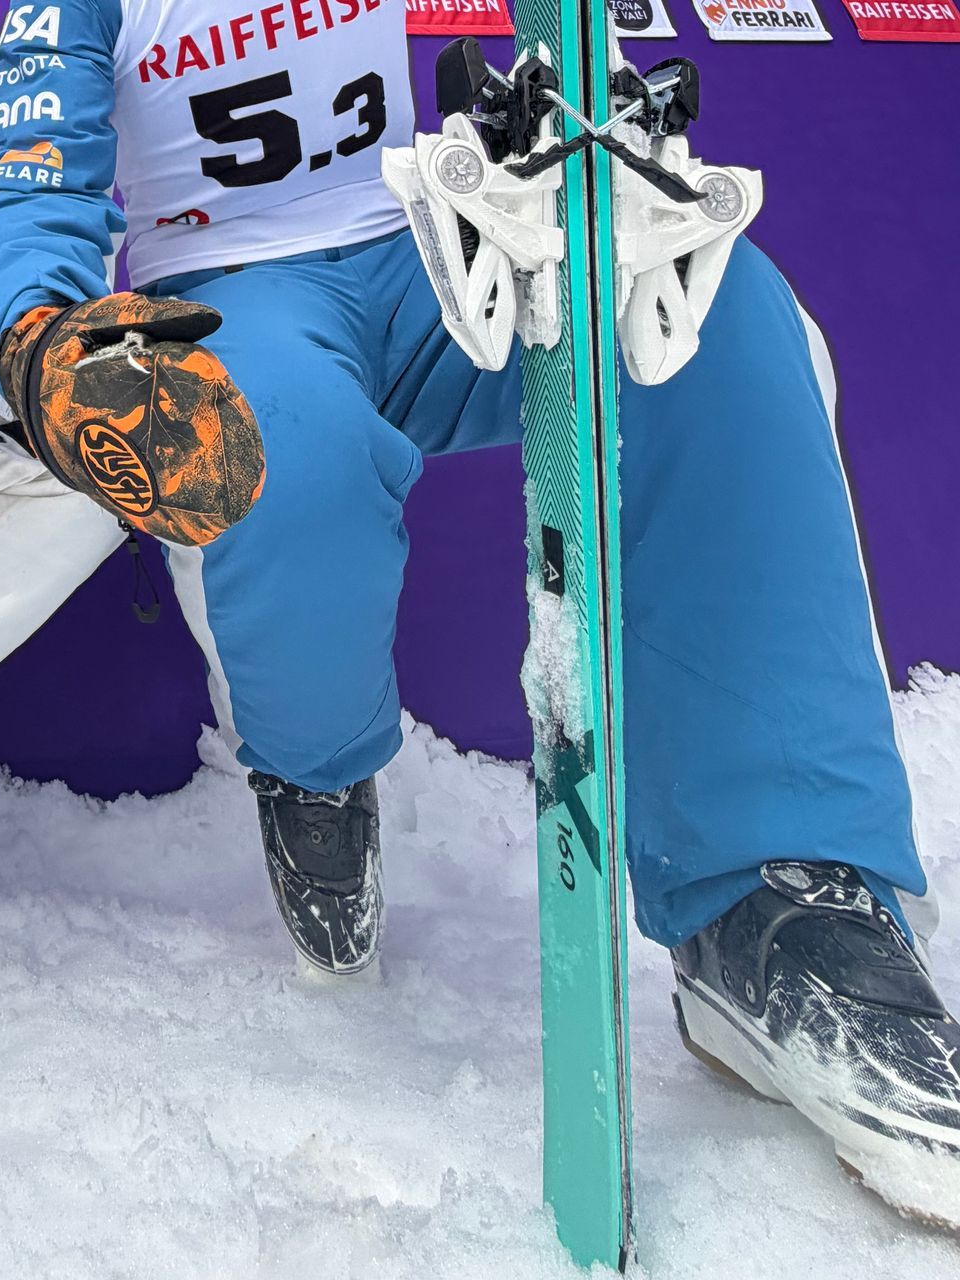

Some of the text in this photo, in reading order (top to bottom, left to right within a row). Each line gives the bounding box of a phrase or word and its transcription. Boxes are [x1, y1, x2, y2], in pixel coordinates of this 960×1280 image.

[610, 0, 643, 11] ZONA
[848, 1, 956, 21] RAIFFEISEN
[731, 9, 816, 29] FERRARI
[188, 69, 387, 189] 5.3
[556, 820, 576, 892] 160
